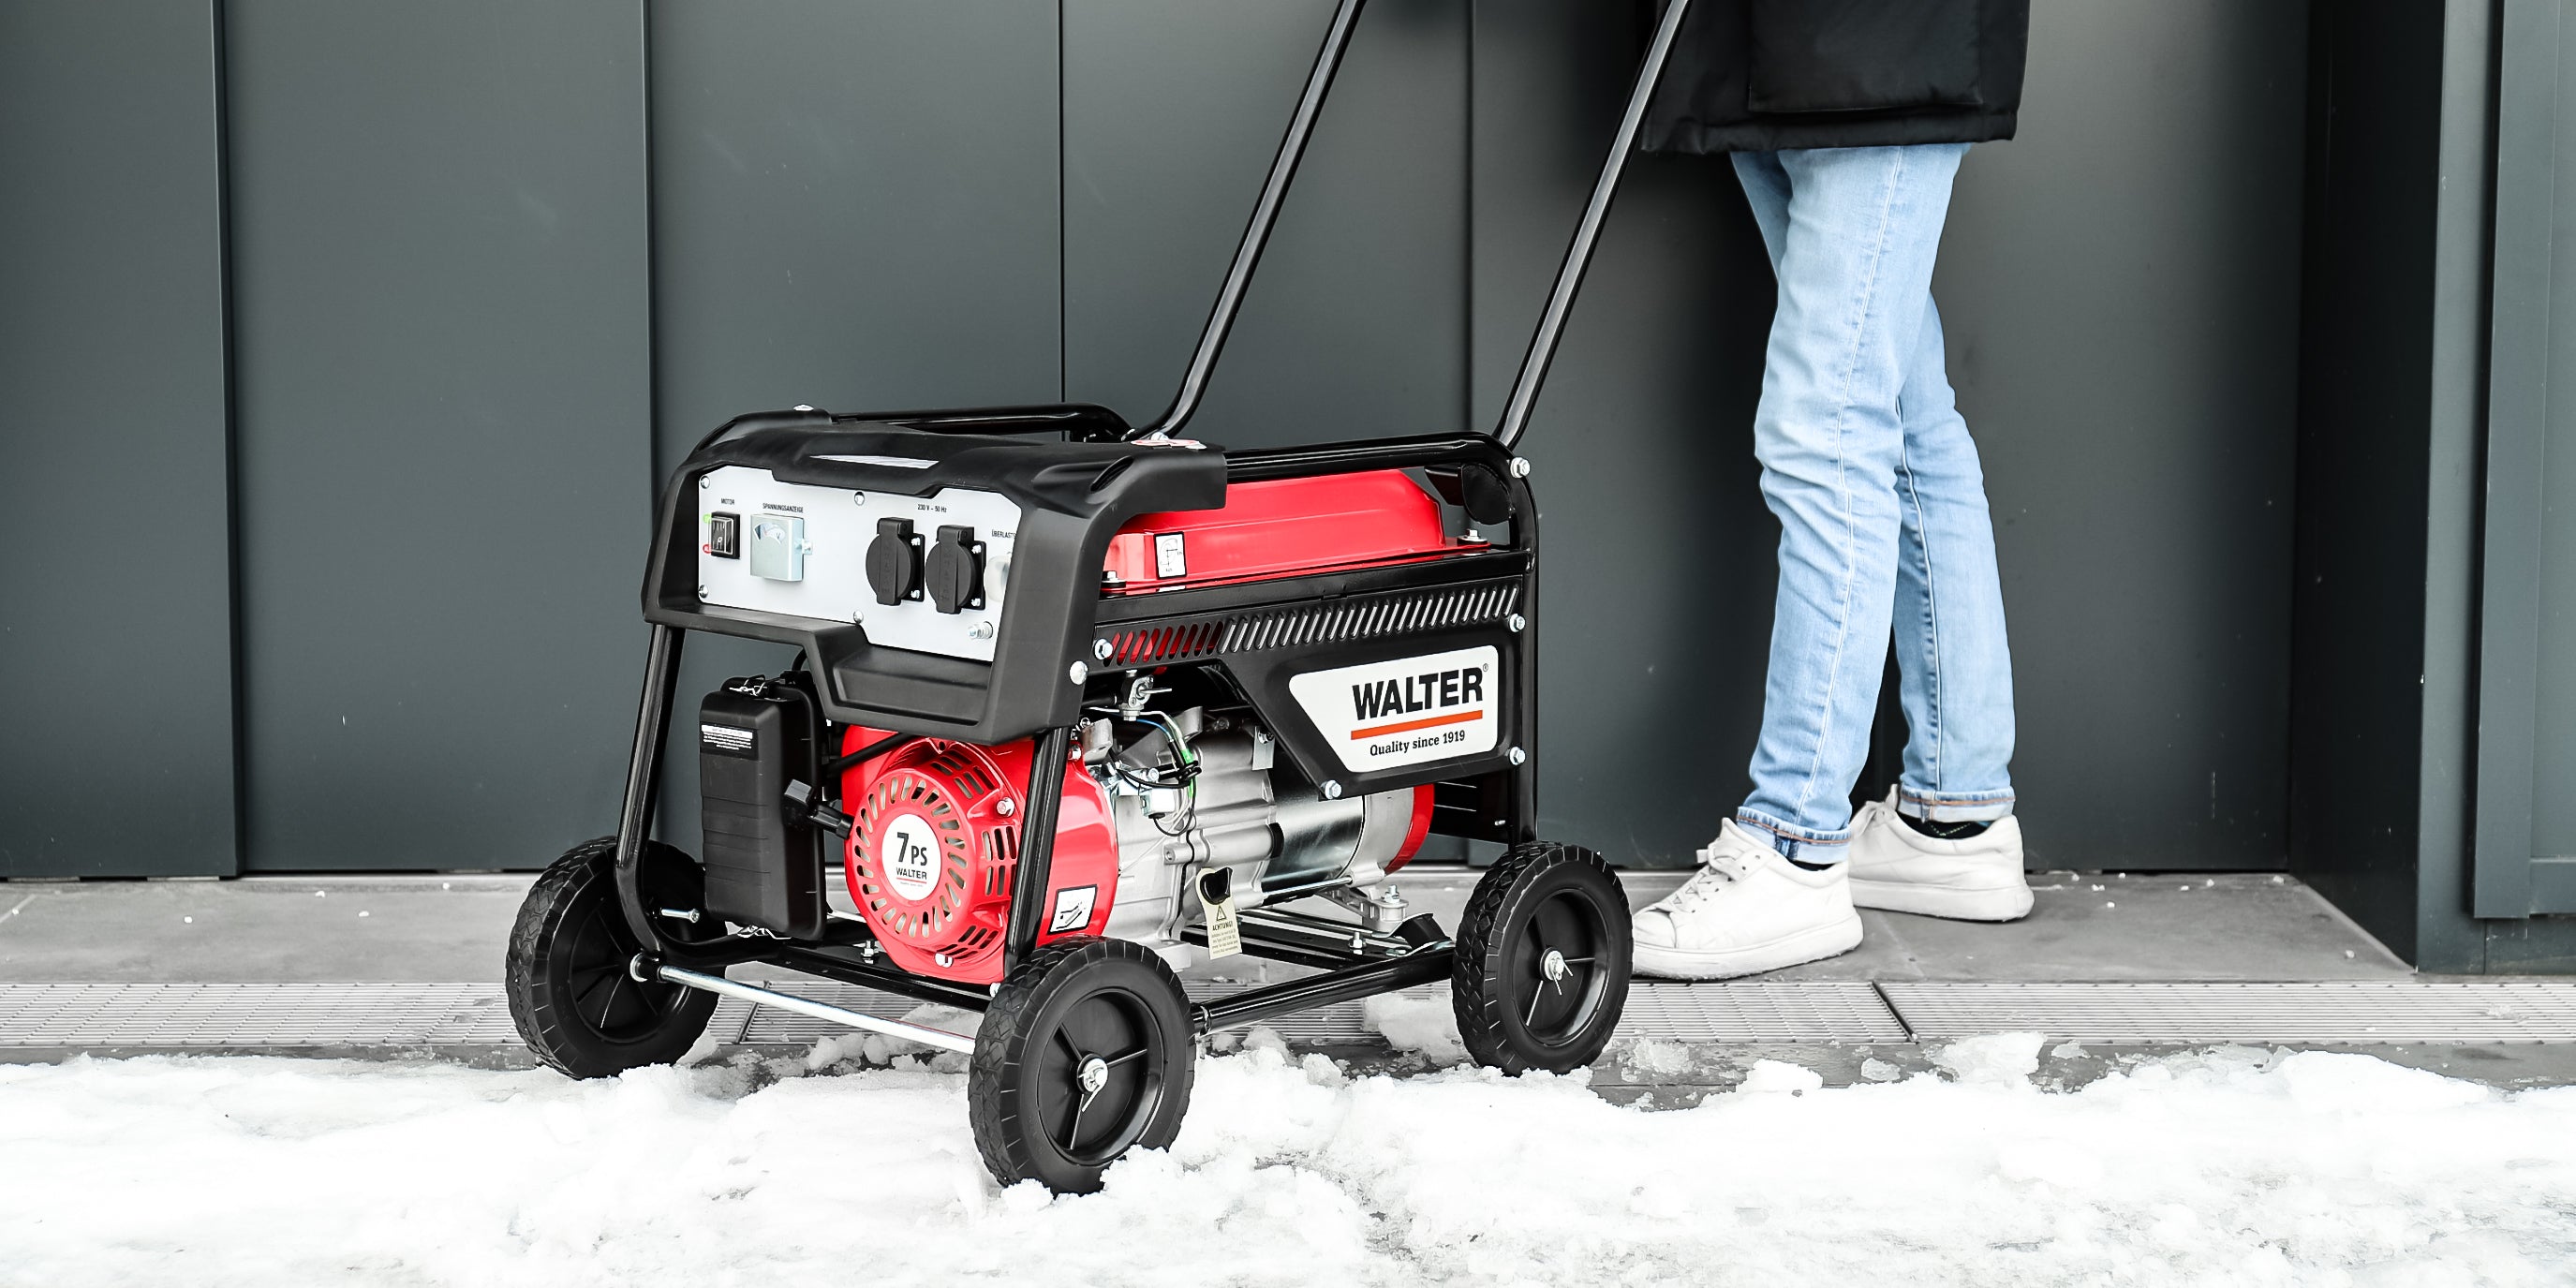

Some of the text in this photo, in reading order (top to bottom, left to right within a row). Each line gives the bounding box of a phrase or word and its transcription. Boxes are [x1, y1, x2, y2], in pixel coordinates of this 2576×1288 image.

[1369, 730, 1465, 756] Quality since 1919
[896, 832, 927, 866] 7 PS
[896, 866, 927, 880] WALTER
